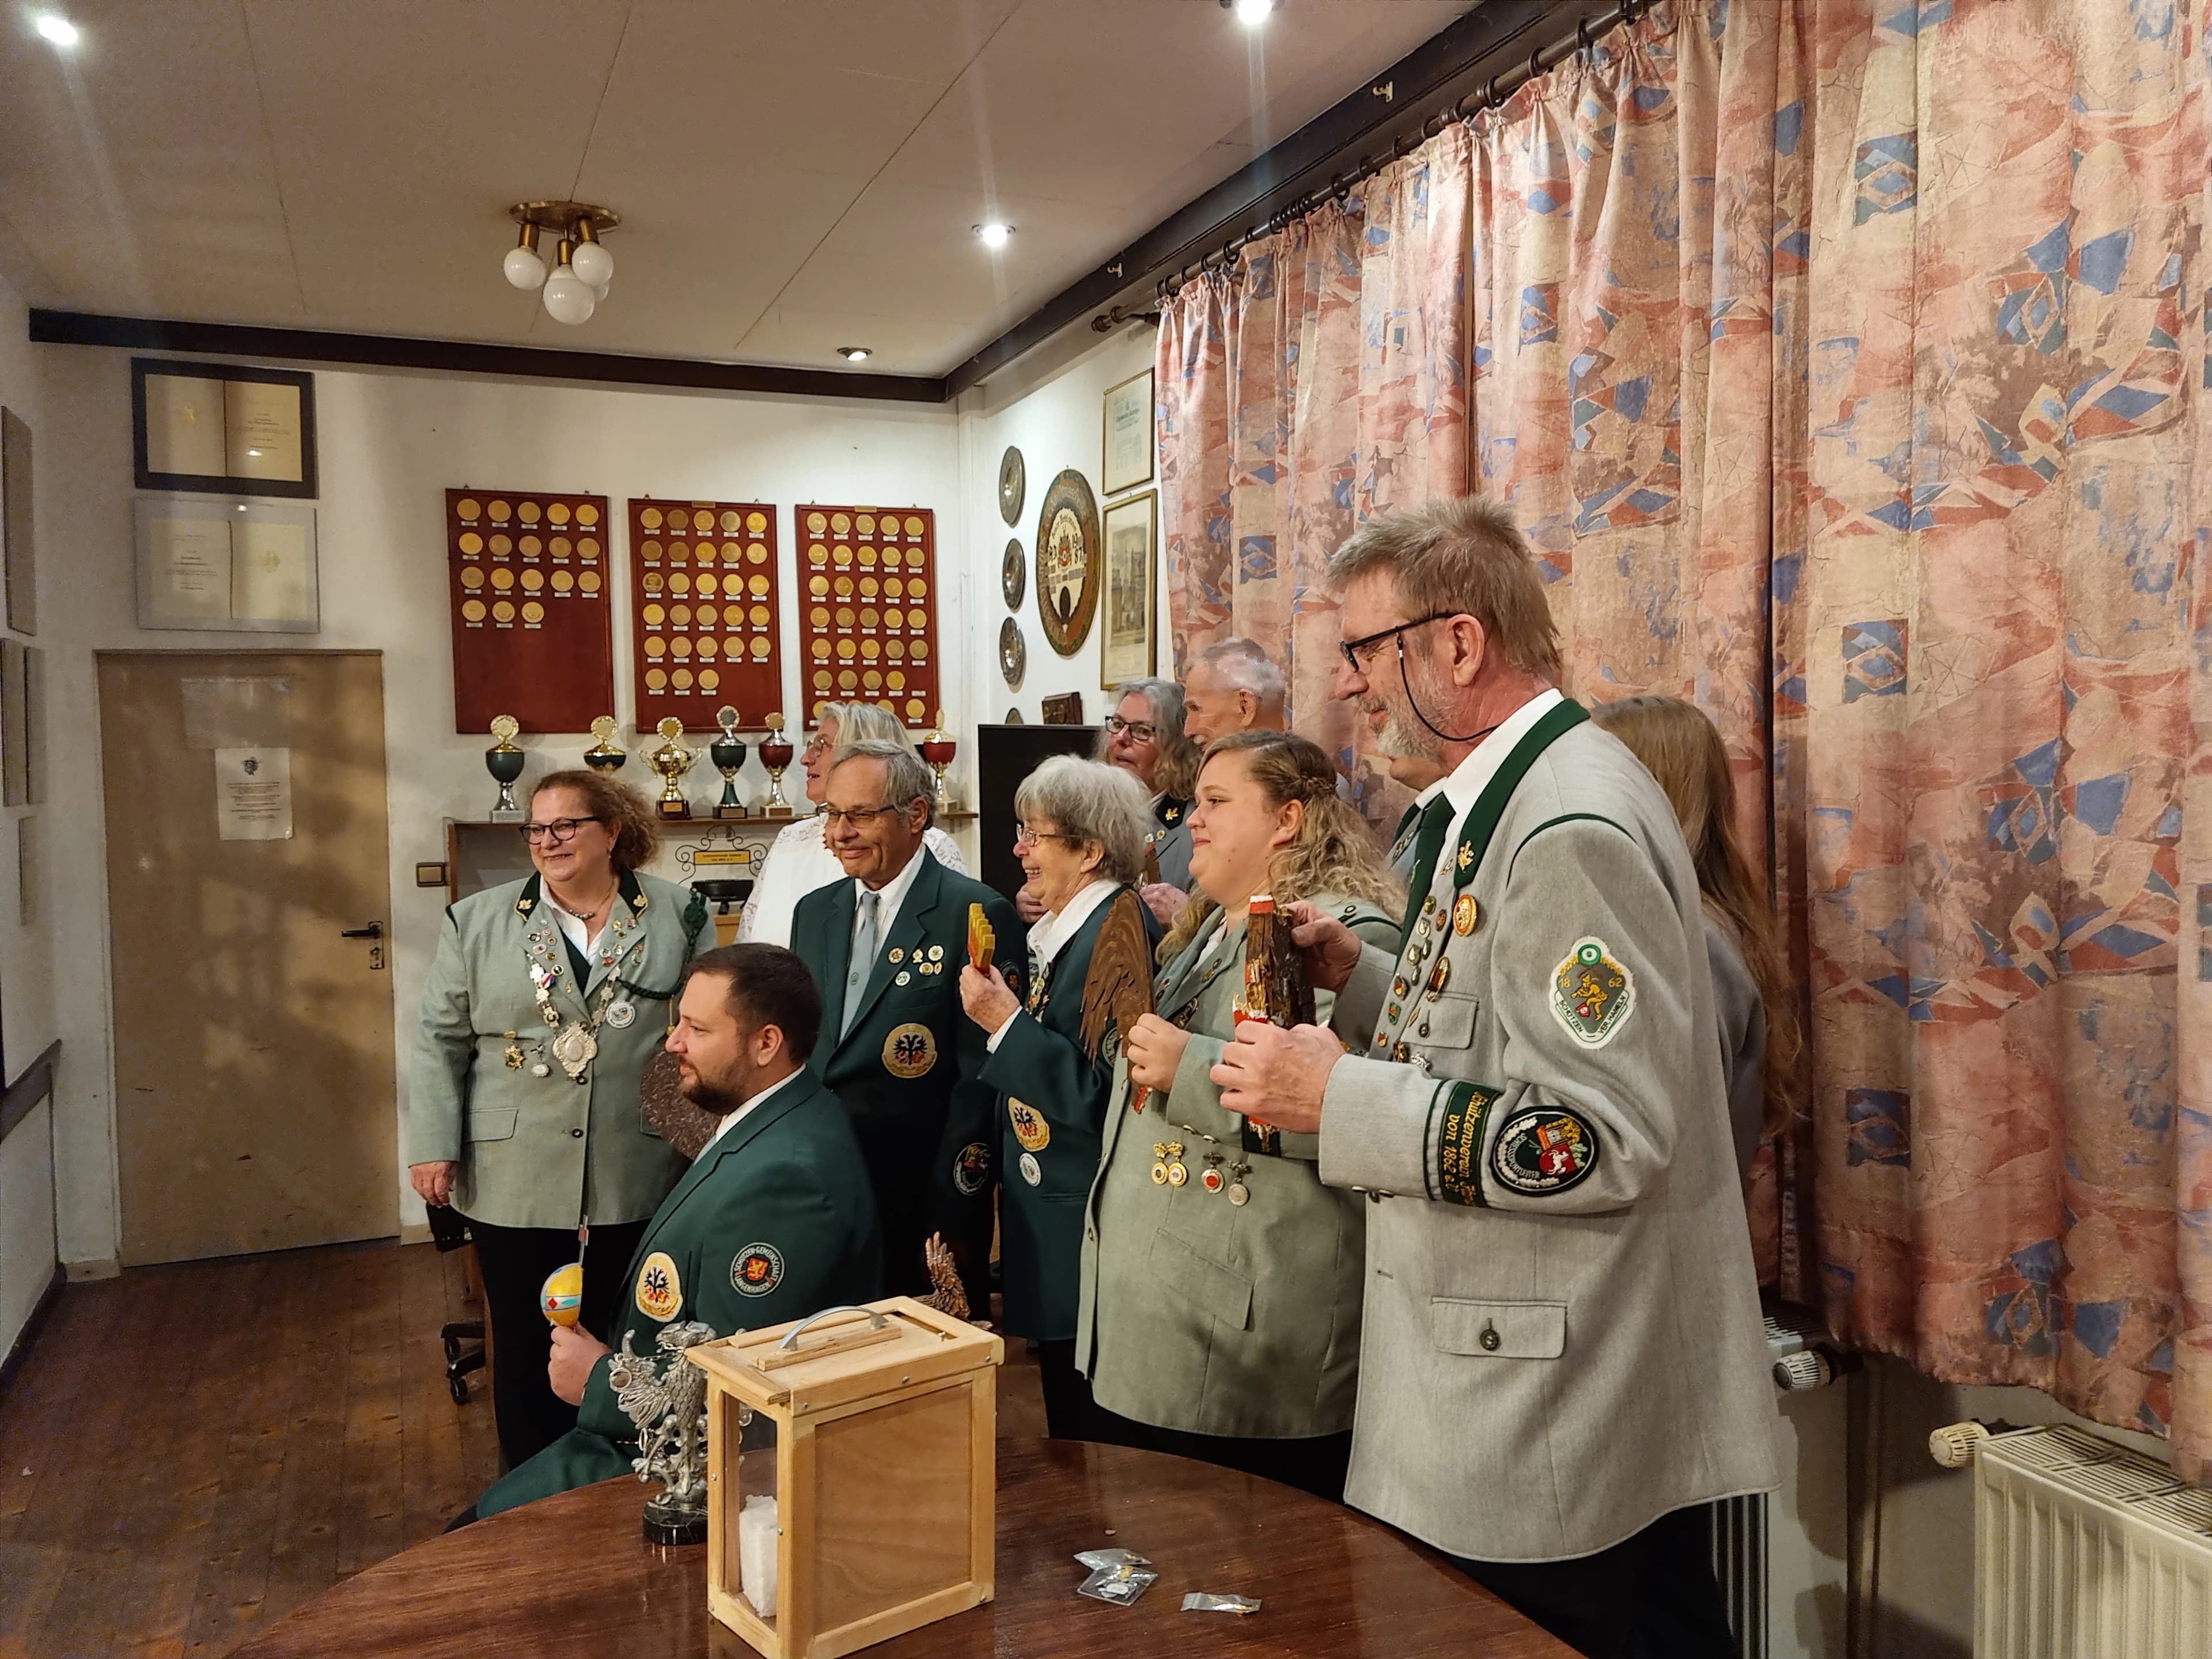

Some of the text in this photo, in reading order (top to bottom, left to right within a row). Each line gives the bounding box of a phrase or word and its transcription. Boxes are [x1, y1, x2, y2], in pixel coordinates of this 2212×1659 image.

[1558, 977, 1623, 988] 18 62
[1445, 1113, 1461, 1141] von
[1443, 1145, 1457, 1173] 1862
